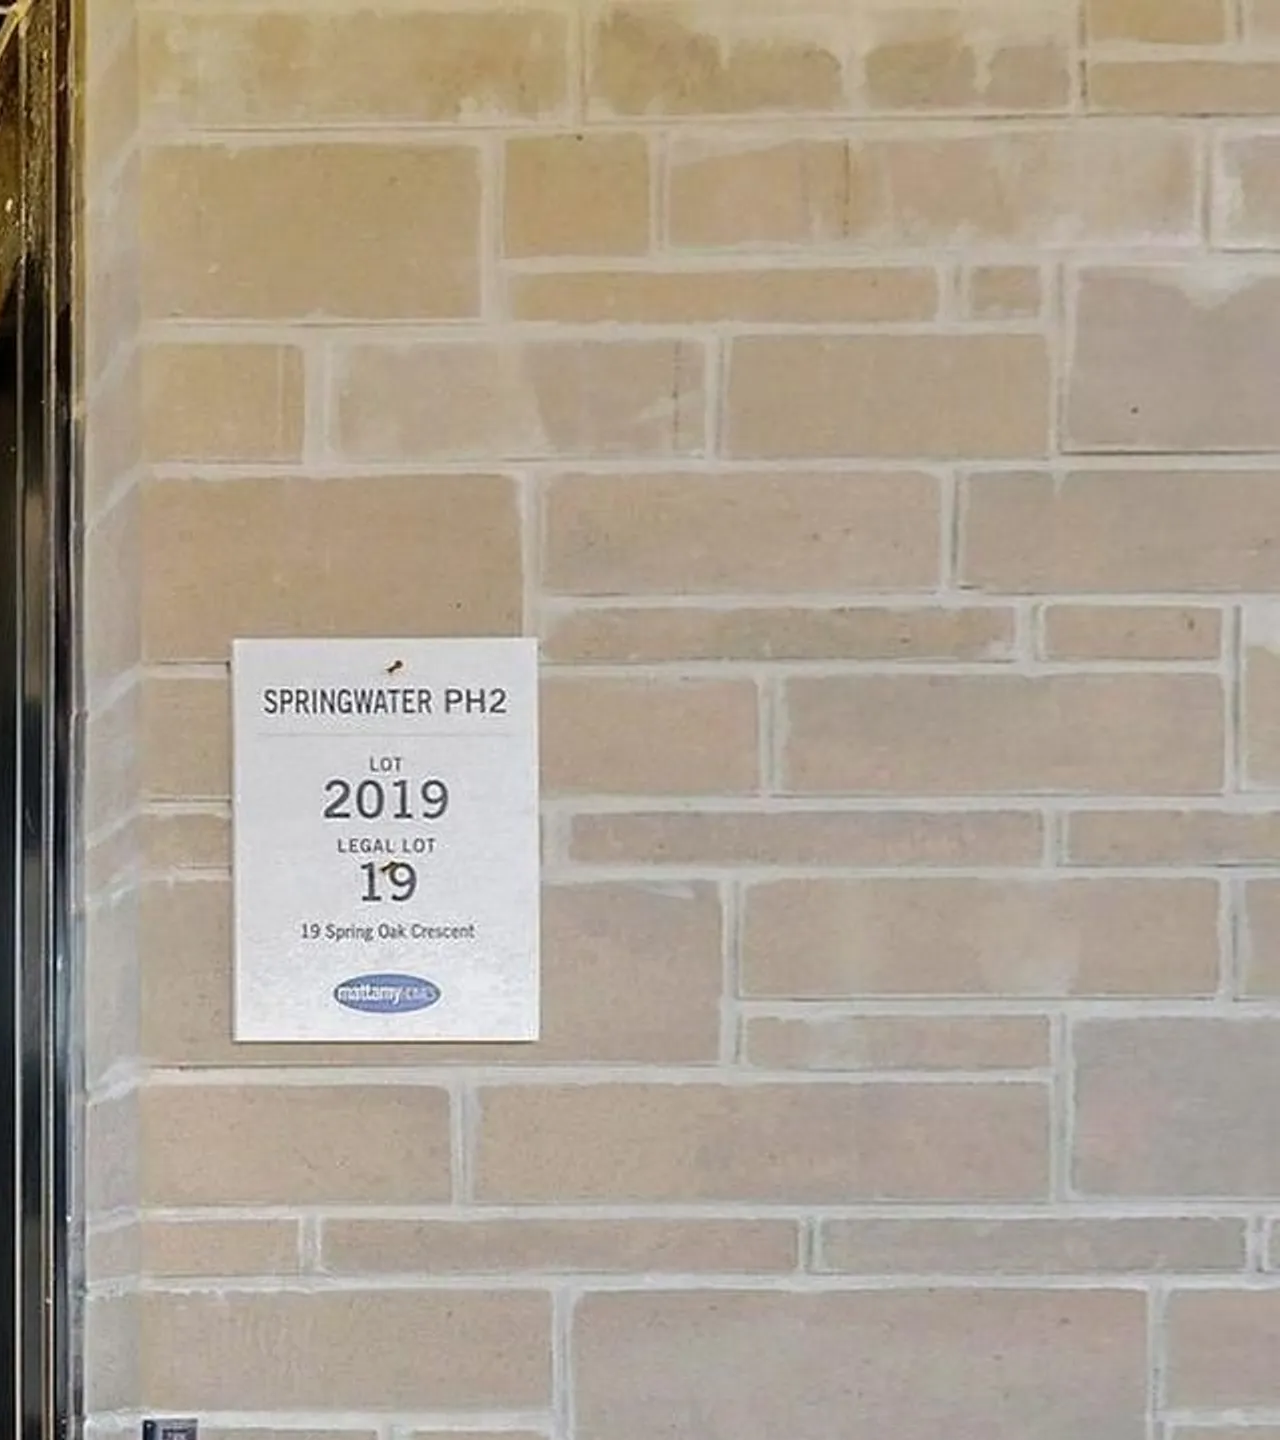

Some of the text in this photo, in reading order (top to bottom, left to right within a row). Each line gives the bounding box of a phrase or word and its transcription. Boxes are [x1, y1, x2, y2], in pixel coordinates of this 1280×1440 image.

[263, 687, 508, 714] SPRINGWATER PH2
[369, 756, 403, 772] LOT
[322, 778, 450, 820] 2019
[337, 837, 437, 854] LEGAL LOT
[359, 860, 418, 903] 19
[301, 923, 476, 942] 19 Spring Oak Crescent
